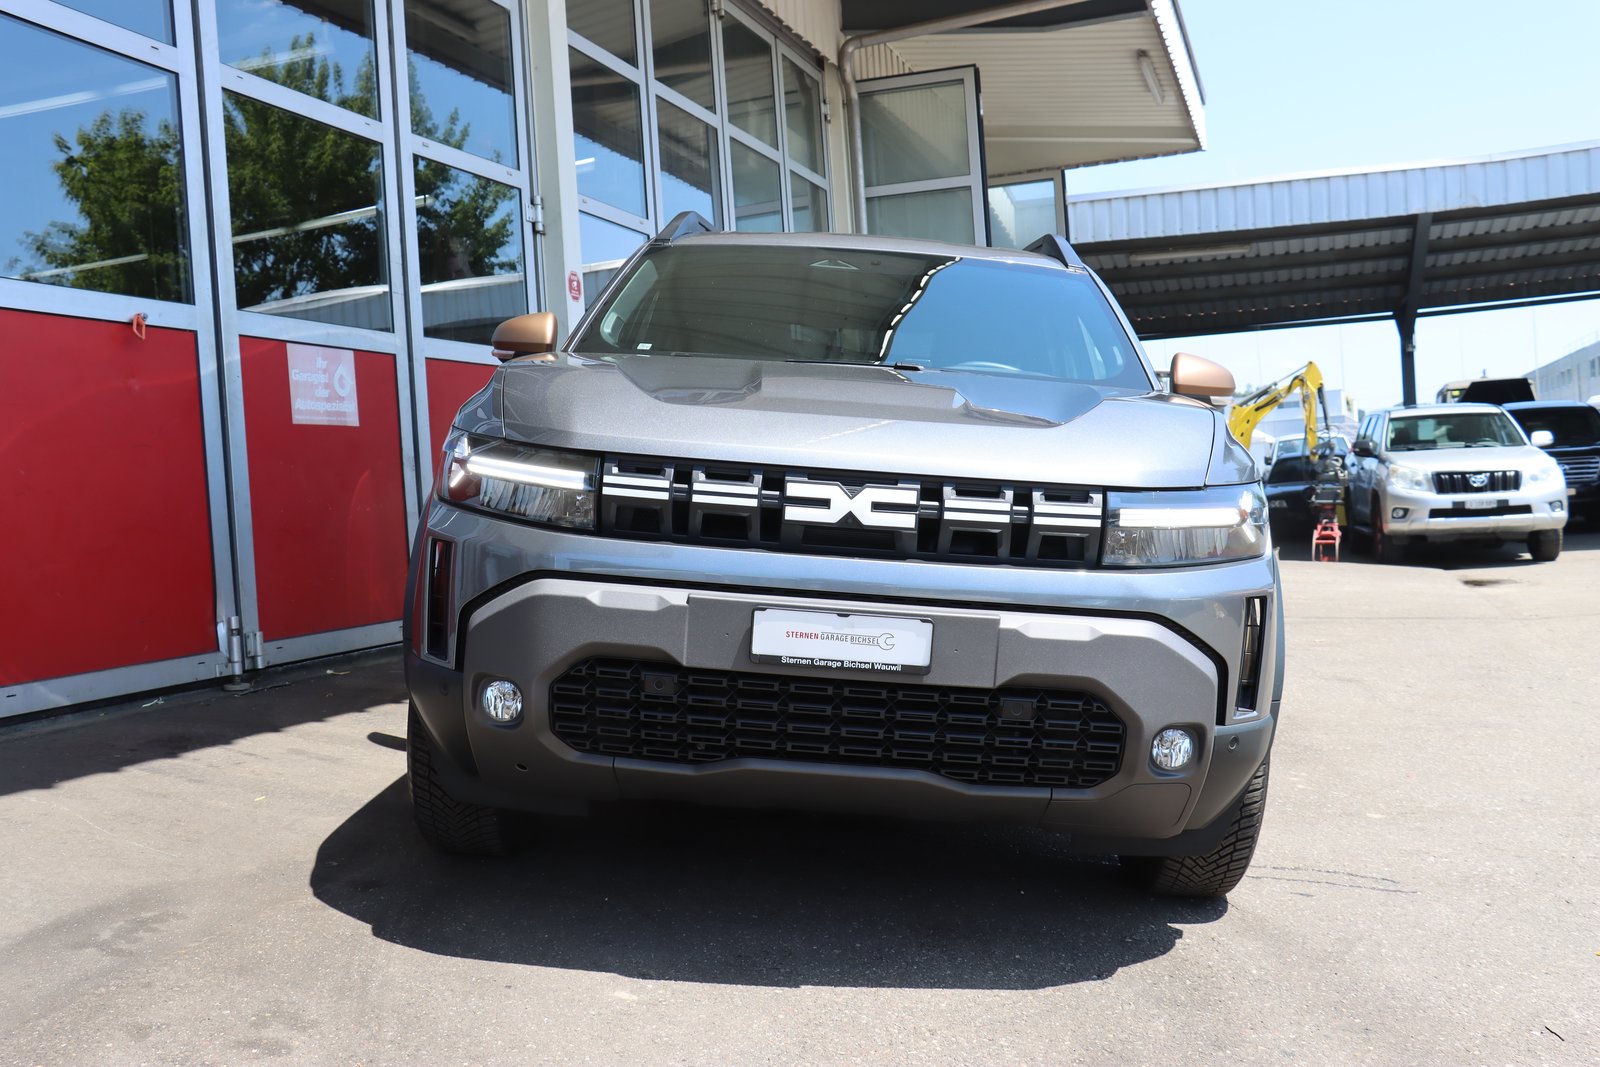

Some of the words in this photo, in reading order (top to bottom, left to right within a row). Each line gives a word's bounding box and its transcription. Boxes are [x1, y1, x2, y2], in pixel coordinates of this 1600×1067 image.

[786, 630, 819, 640] STERNEN
[820, 633, 849, 643] GARAGE
[850, 635, 880, 645] BICHSEL
[781, 655, 811, 665] Sternen
[813, 658, 842, 668] Garage
[843, 660, 872, 670] Bichsel
[873, 662, 902, 672] Wauwil
